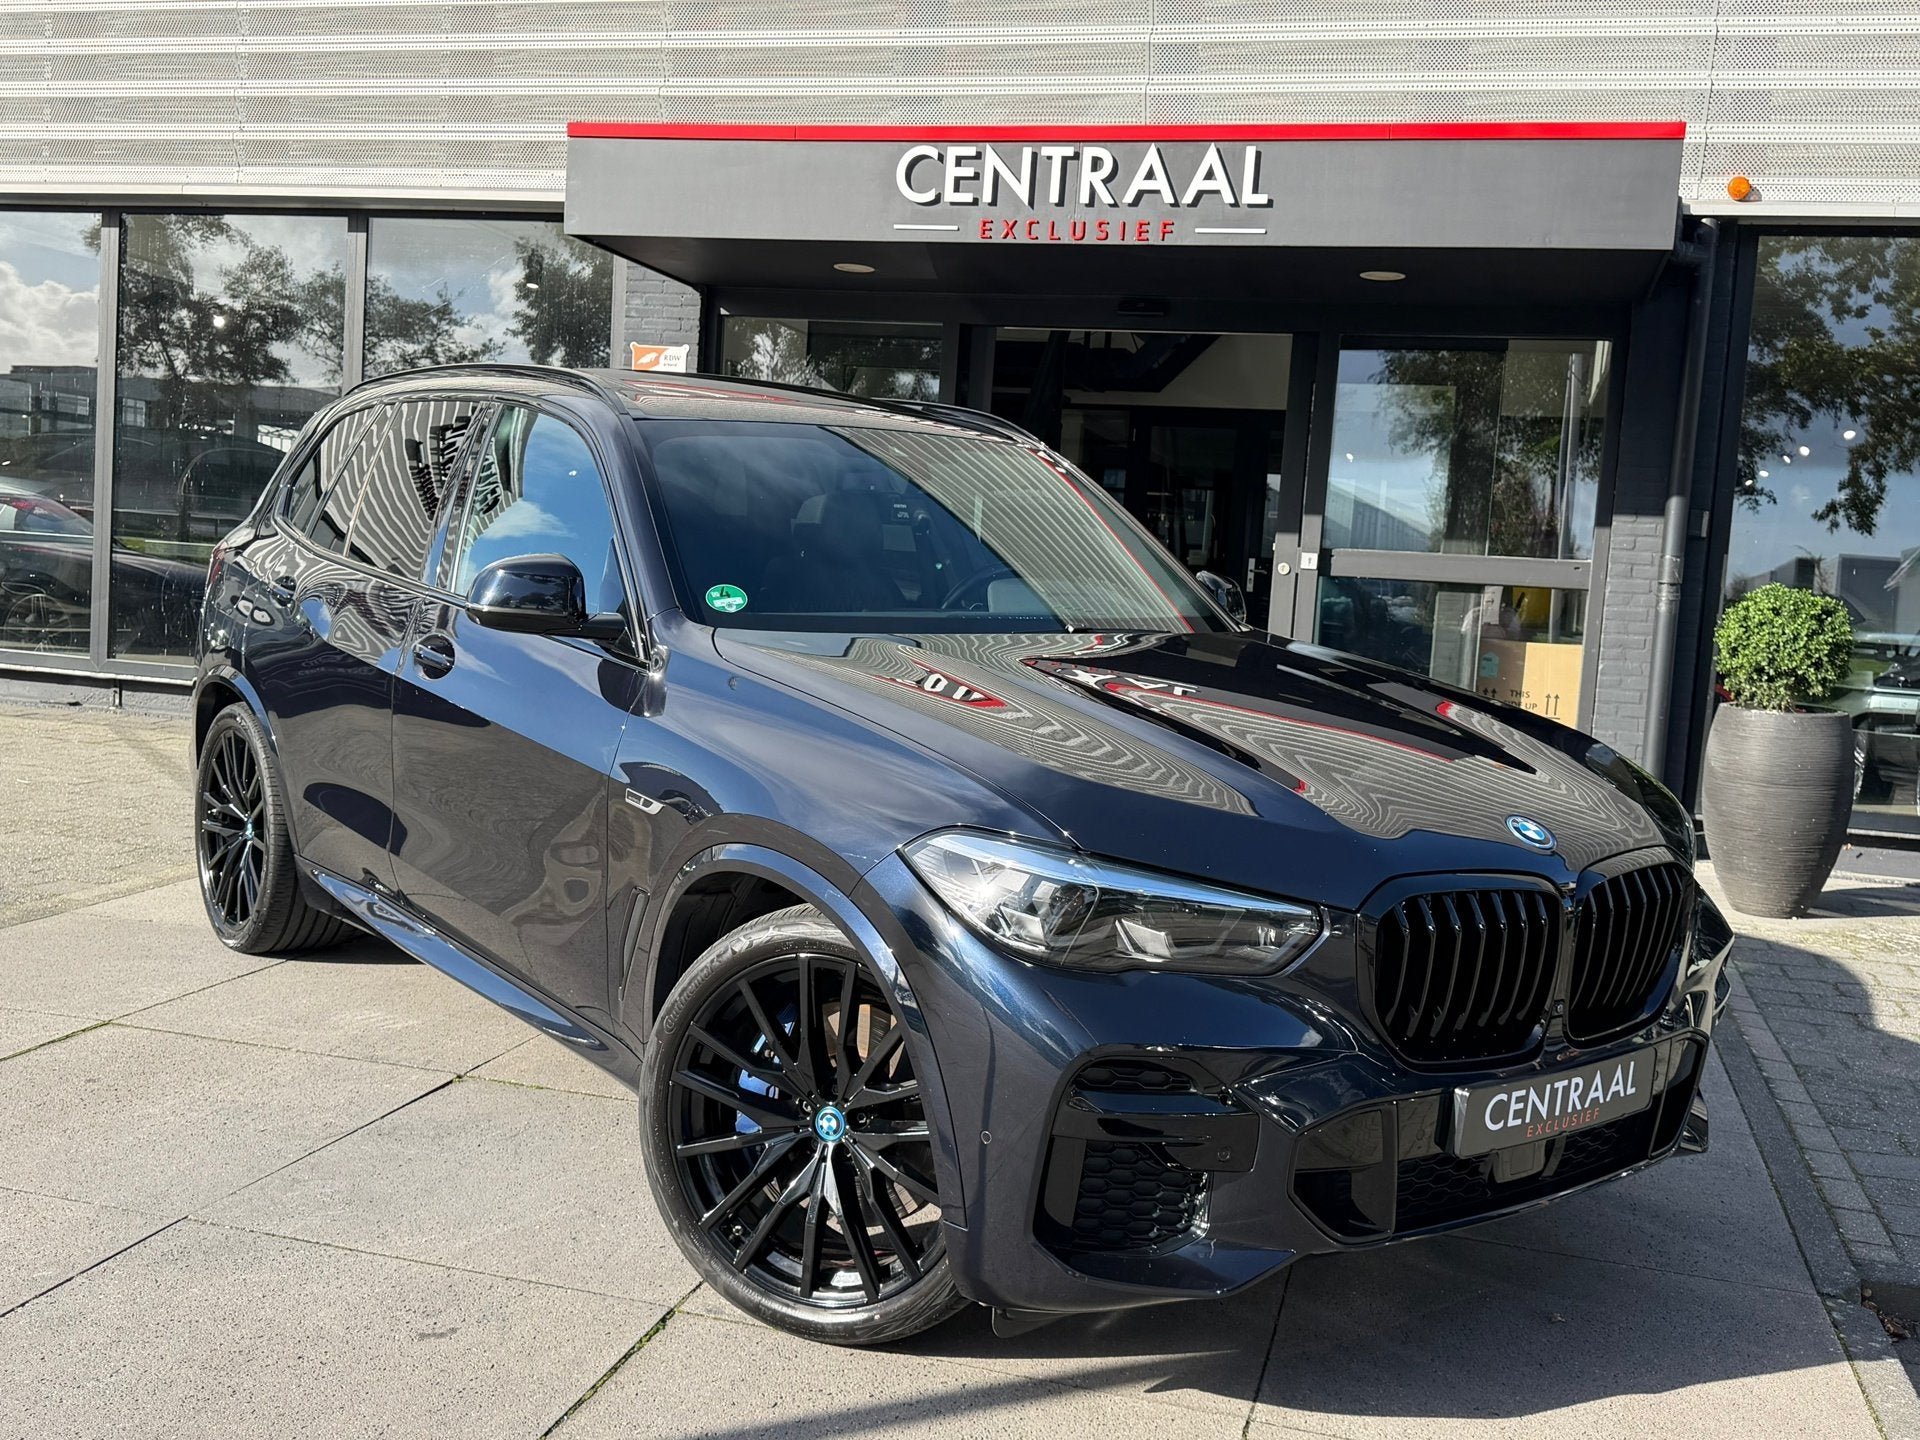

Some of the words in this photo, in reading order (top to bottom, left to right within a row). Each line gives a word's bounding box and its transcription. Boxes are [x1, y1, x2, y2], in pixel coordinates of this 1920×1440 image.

[895, 143, 1272, 208] CENTRAAL
[978, 218, 1175, 241] EXCLUSIEF
[1510, 690, 1531, 699] THIS
[1525, 703, 1538, 711] UP
[1484, 1061, 1636, 1131] CENTRAAL
[1526, 1107, 1600, 1138] EXCLUSIEF
